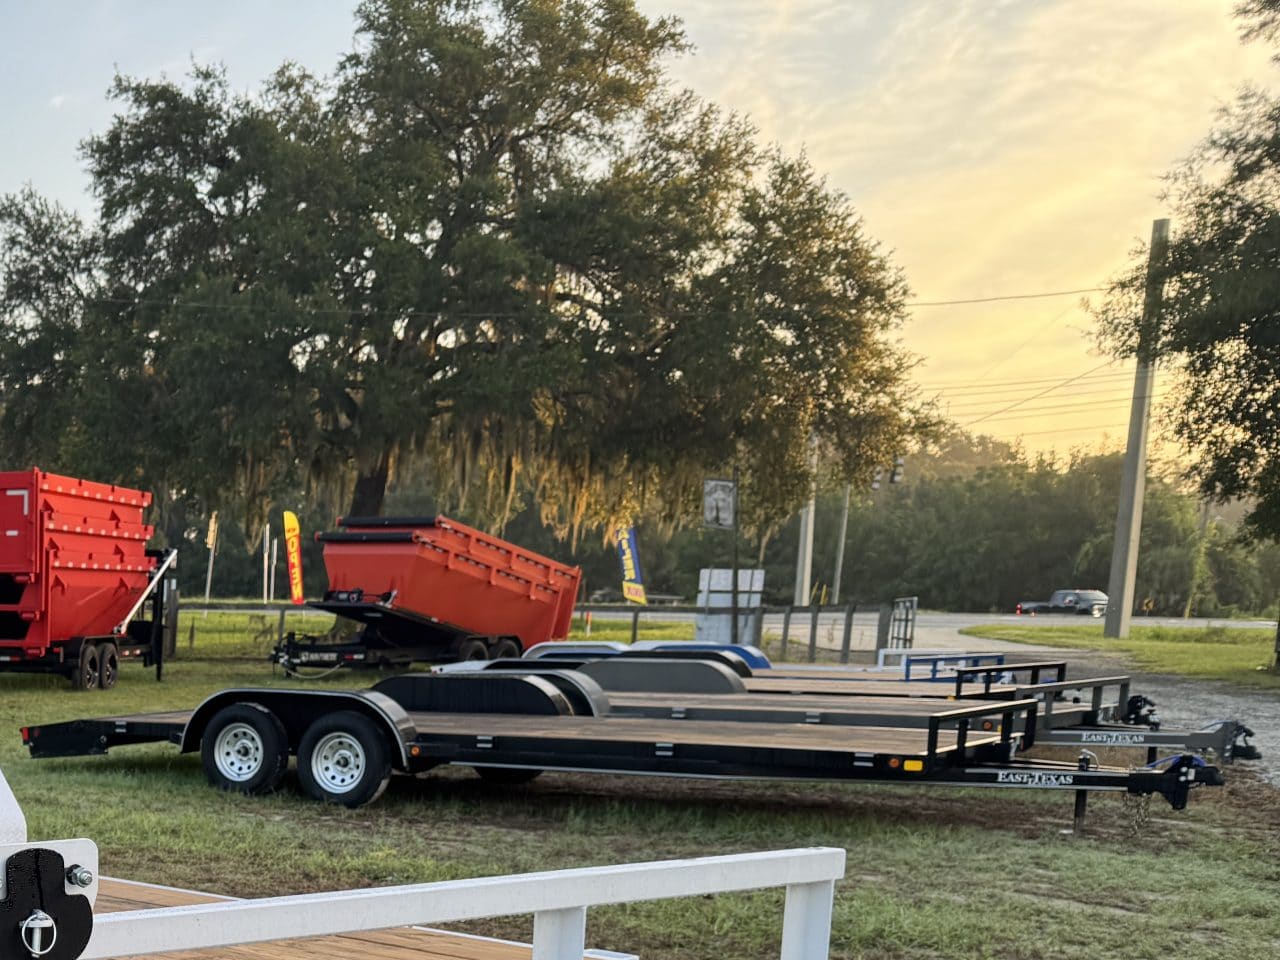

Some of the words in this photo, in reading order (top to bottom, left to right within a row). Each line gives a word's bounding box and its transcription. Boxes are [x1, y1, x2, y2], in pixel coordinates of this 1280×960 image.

[1082, 731, 1108, 742] EAST
[1107, 731, 1145, 744] TEXAS
[998, 770, 1029, 783] EAST
[1031, 771, 1074, 786] TEXAS
